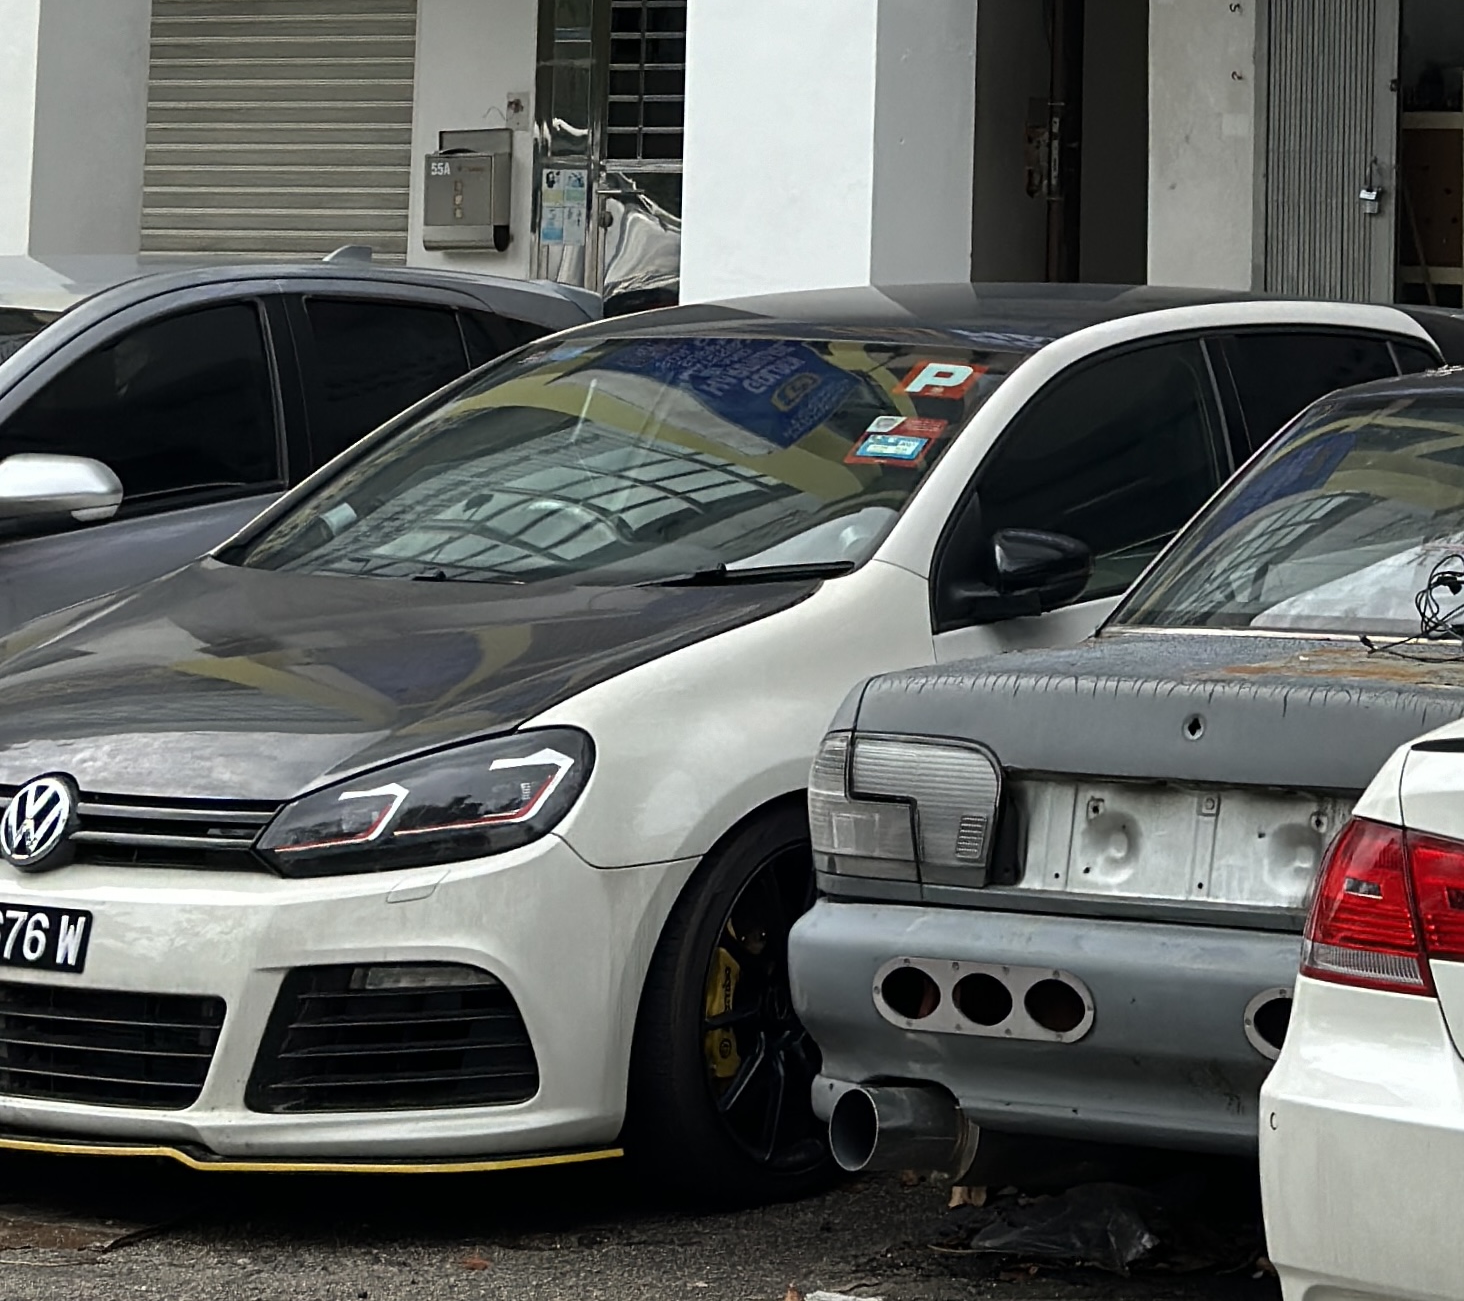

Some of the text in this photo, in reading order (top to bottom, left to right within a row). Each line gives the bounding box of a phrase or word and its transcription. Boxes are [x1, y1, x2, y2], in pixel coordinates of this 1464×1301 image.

[430, 161, 451, 176] 55A
[905, 363, 974, 393] P
[0, 910, 86, 966] 76 W
